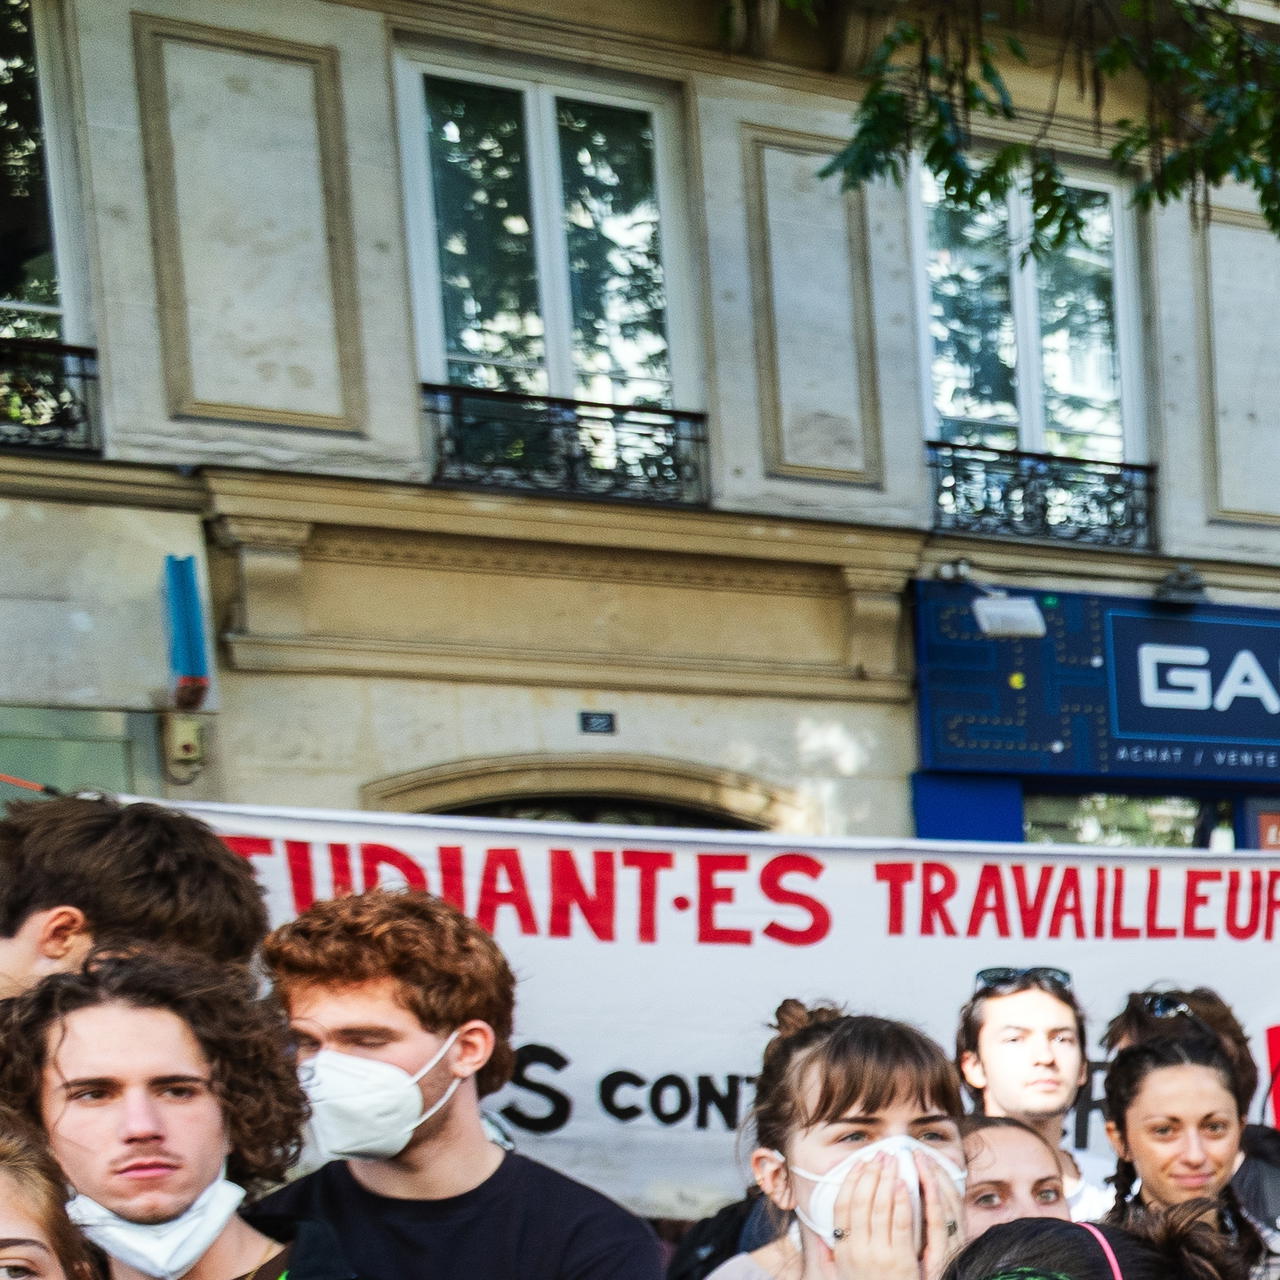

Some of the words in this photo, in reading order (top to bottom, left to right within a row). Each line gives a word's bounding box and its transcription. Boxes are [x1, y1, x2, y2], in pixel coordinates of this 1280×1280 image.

[1115, 745, 1184, 764] ACHAT
[1213, 750, 1280, 769] VENTE
[599, 1069, 757, 1132] CON
